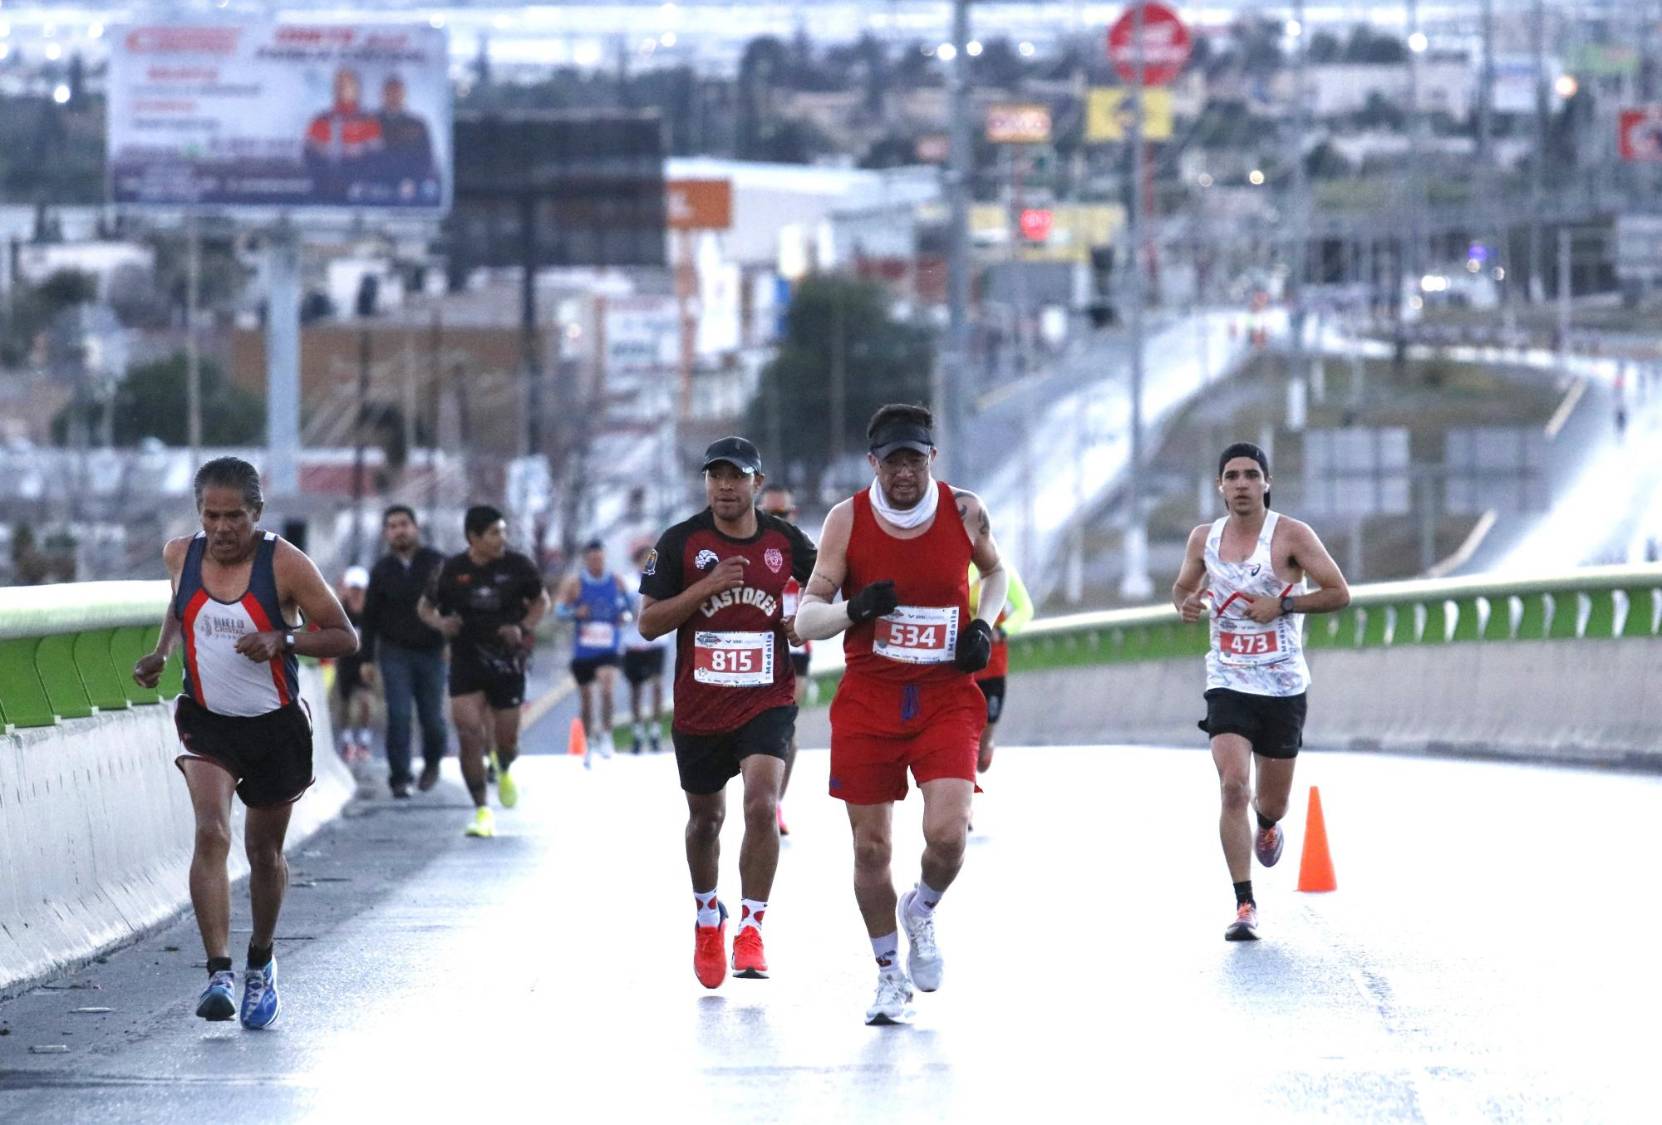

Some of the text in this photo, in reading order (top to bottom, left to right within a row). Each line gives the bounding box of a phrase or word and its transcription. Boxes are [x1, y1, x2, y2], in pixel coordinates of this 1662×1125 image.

[701, 588, 776, 617] CASTORES
[889, 624, 936, 647] 534
[1231, 635, 1268, 652] 473
[712, 651, 753, 671] 815
